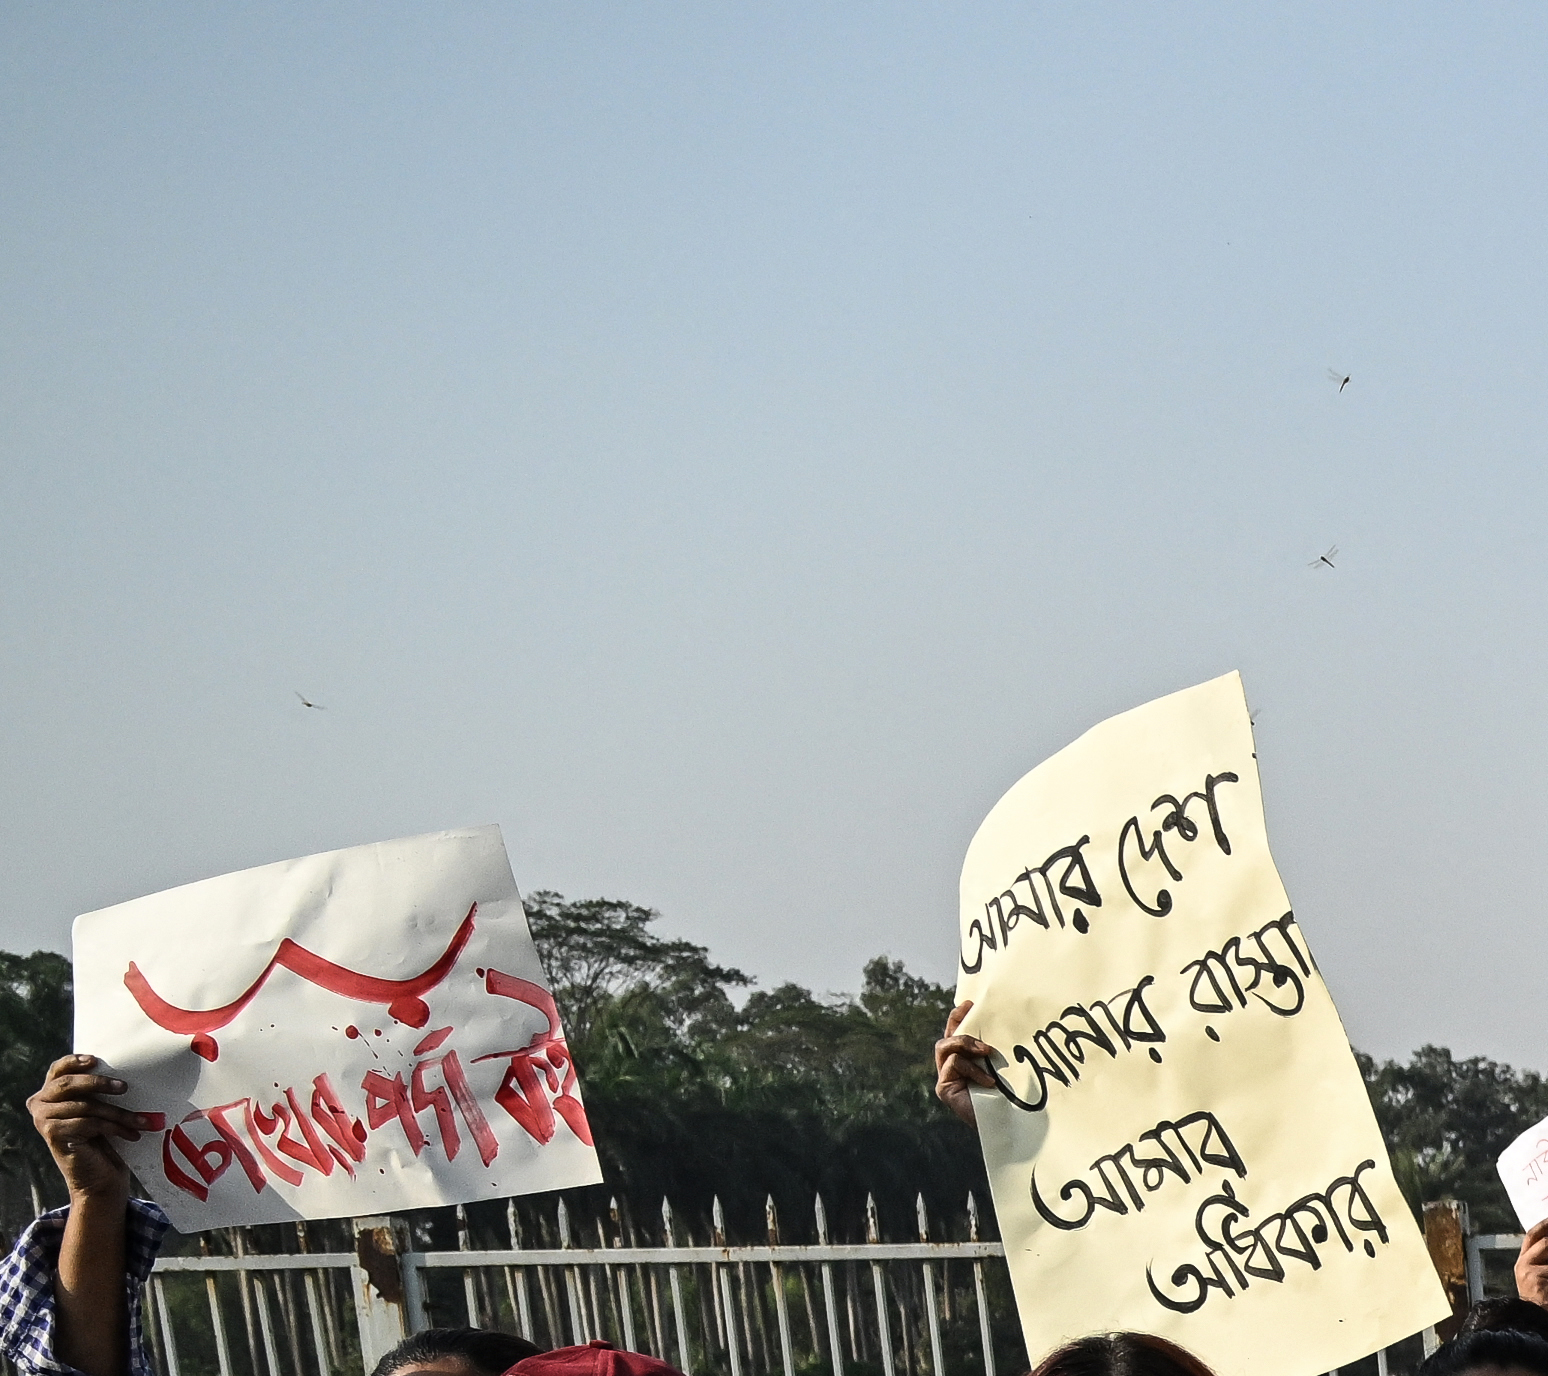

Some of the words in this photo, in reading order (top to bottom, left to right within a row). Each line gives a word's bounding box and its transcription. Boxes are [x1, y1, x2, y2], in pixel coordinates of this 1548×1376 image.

[962, 835, 1102, 974] আমার
[1118, 772, 1239, 917] দেশ
[984, 975, 1166, 1112] আমার
[1181, 912, 1314, 1042] রাস্তা
[1031, 1110, 1248, 1232] আমার
[1146, 1158, 1391, 1315] অধিকার
